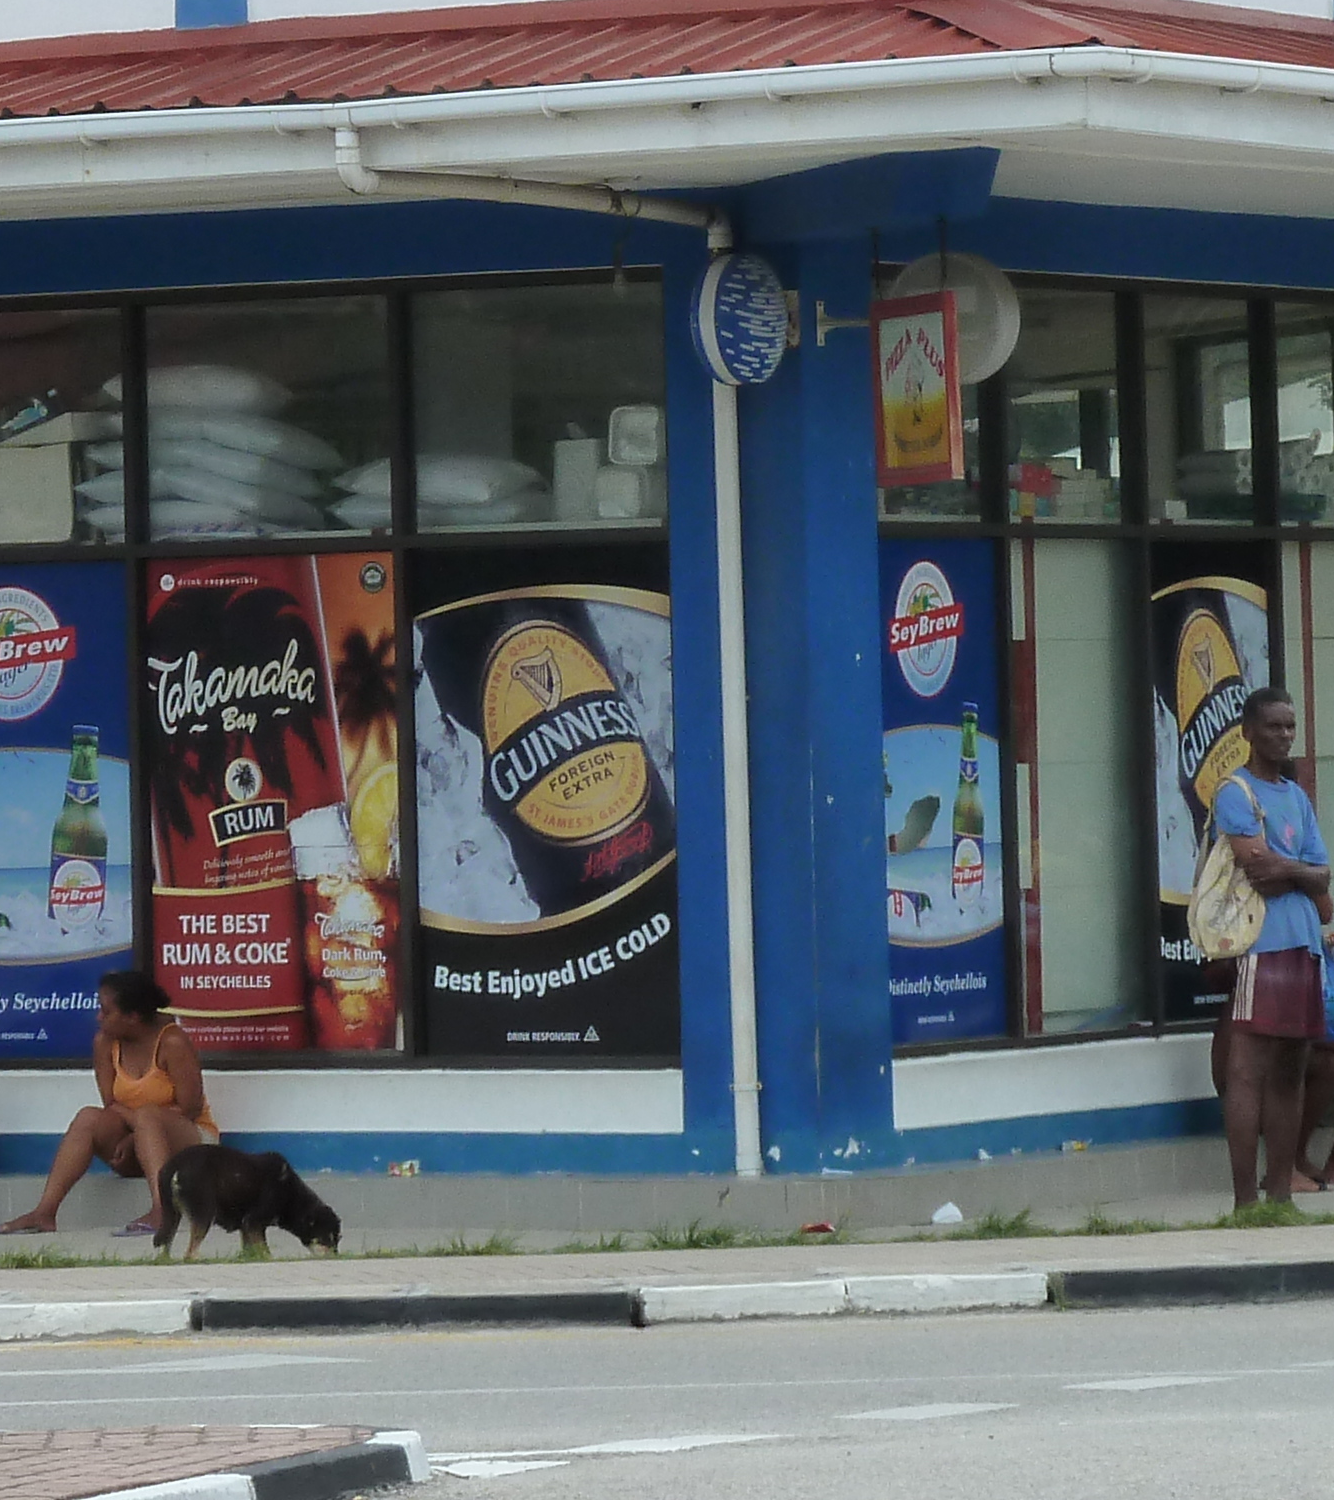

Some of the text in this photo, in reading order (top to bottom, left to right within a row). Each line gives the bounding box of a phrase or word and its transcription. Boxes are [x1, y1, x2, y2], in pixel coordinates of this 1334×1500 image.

[916, 327, 944, 377] PLUS
[890, 612, 960, 645] SeyBrew
[147, 638, 316, 735] Takamaka
[221, 706, 258, 733] Bay
[490, 699, 640, 802] GUINNESS
[548, 750, 616, 793] FOREIGN
[562, 767, 614, 801] EXTRA
[224, 805, 275, 835] RUM
[178, 913, 270, 935] THE BEST
[162, 943, 210, 966] RUM
[215, 942, 231, 965] &
[322, 946, 387, 963] Dark Rum,
[433, 911, 672, 1000] Best Enjoyed ICE COLD
[180, 975, 271, 989] IN SEYCHELLES
[889, 972, 987, 998] istinctly Seychellois
[12, 992, 102, 1013] Seychelloi
[506, 1031, 531, 1042] DRINK
